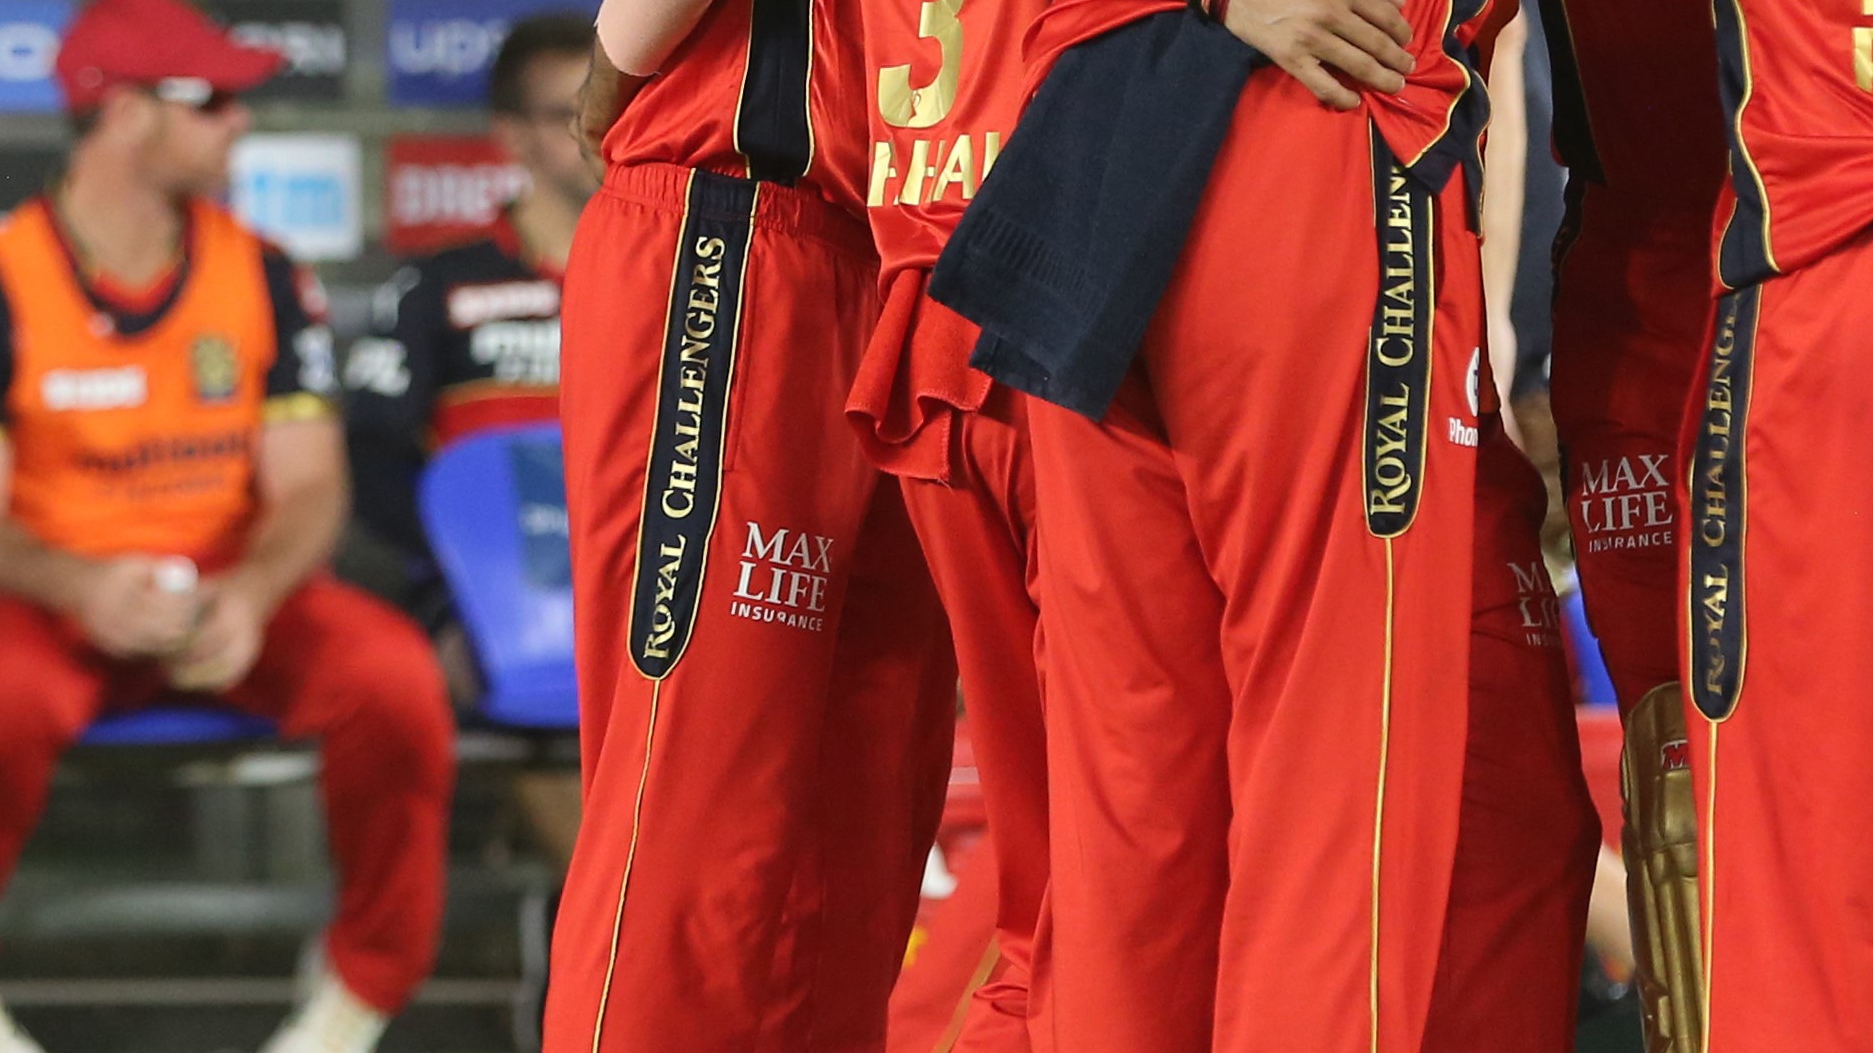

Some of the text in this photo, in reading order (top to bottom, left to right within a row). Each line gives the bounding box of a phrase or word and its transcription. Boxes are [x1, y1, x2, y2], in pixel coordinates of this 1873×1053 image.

[1369, 164, 1413, 516] ROYAL CHALLEN
[643, 236, 725, 660] ROYAL CHALLENGERS
[1582, 454, 1669, 496] MAX
[1581, 491, 1673, 534] LIFE
[742, 521, 834, 573] MAX
[733, 560, 828, 613] LIFE
[730, 601, 823, 632] INSURANCE
